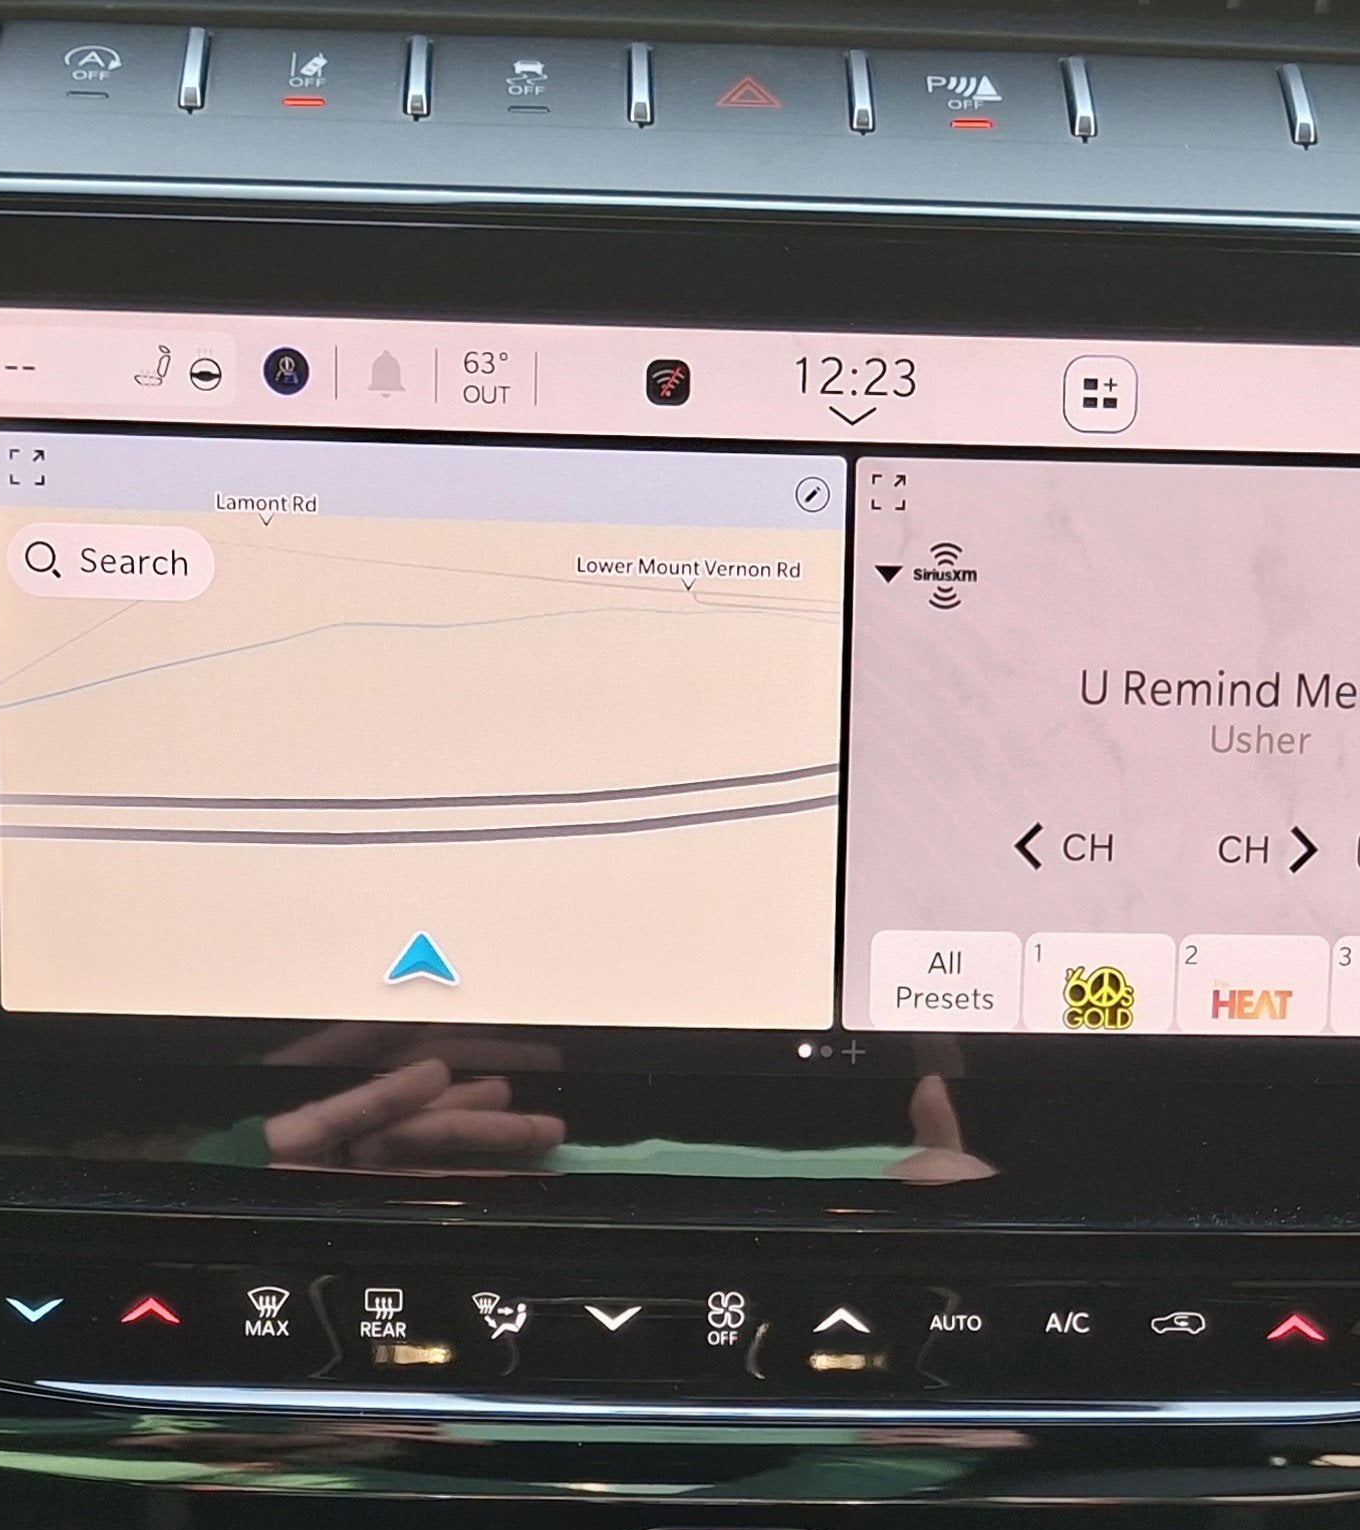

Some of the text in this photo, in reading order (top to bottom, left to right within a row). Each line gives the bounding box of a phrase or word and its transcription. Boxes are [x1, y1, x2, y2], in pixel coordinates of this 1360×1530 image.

[72, 70, 110, 82] OFF
[288, 77, 327, 88] OFF
[507, 86, 545, 96] OFF
[947, 100, 984, 110] OFF
[464, 351, 508, 374] 63°
[797, 357, 915, 397] 12:23
[463, 385, 510, 404] OUT
[215, 494, 317, 513] Lamont Rd
[81, 548, 187, 576] Search
[577, 557, 800, 578] Lower Mount Vernon Rd
[1082, 670, 1107, 705] U
[1125, 670, 1280, 708] Remind
[1297, 673, 1357, 709] Me
[1211, 724, 1311, 754] Usher
[1063, 834, 1113, 861] CH
[1219, 836, 1268, 863] CH
[928, 951, 961, 974] All
[1036, 943, 1041, 962] 1
[1185, 945, 1197, 965] 2
[1339, 947, 1351, 966] 3
[897, 986, 993, 1010] Presets
[1211, 989, 1293, 1020] HEAT
[1062, 1007, 1133, 1030] GOLD
[245, 1320, 289, 1336] MAX
[361, 1321, 406, 1337] REAR
[930, 1315, 982, 1331] AUTO
[1046, 1312, 1089, 1333] A/C
[708, 1331, 737, 1345] OFF
